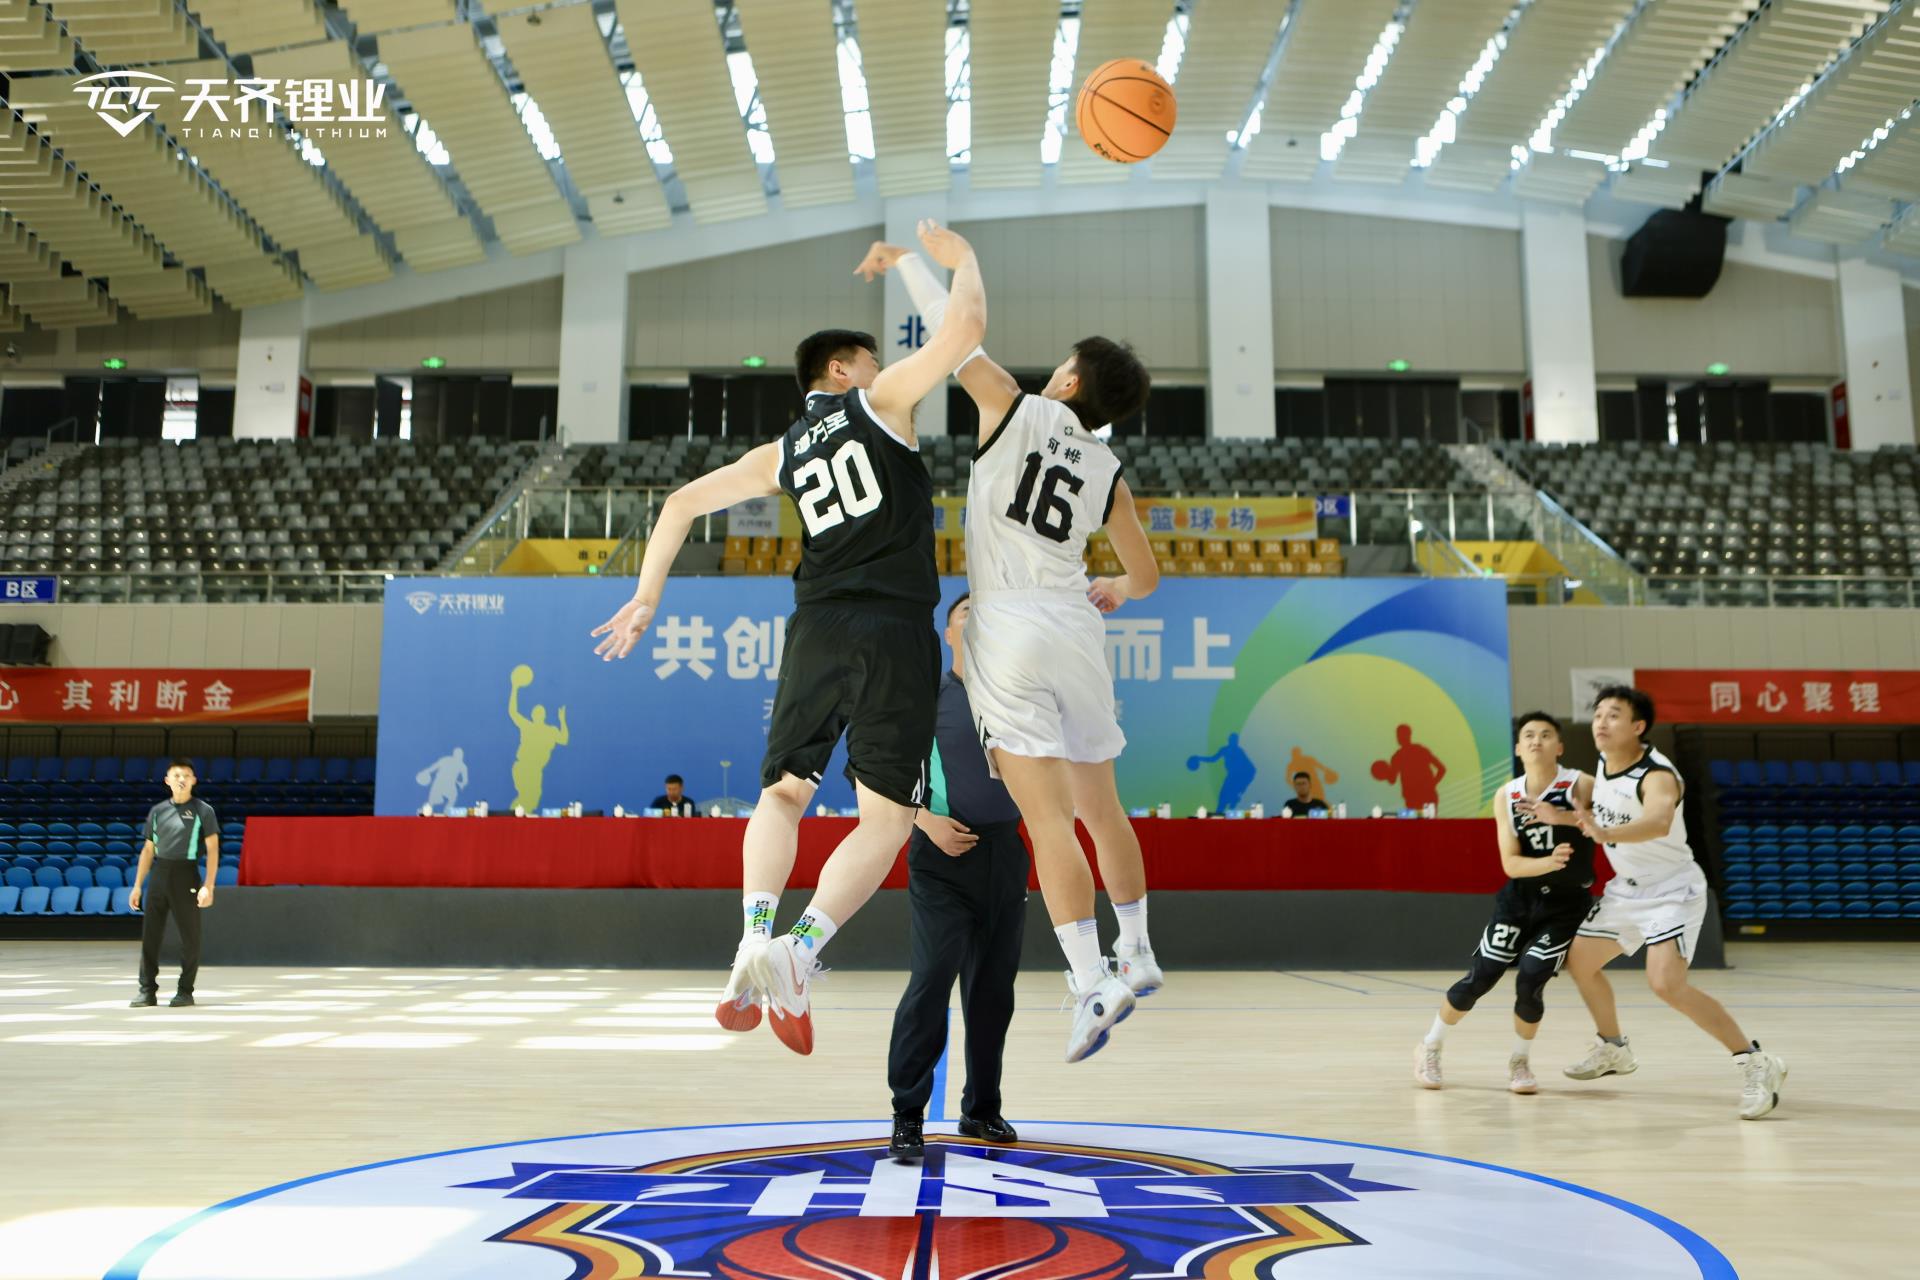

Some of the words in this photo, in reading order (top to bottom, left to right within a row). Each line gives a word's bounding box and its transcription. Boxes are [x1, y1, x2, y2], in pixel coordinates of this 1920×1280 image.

[793, 440, 883, 538] 20
[1005, 450, 1085, 543] 16
[1149, 506, 1257, 532] 篮球场
[6, 581, 38, 598] B区
[652, 616, 785, 681] 共创
[1104, 617, 1236, 682] 而上
[62, 679, 234, 711] 其利断金
[1710, 681, 1881, 713] 同心聚锂
[1525, 826, 1555, 850] 27
[1491, 923, 1521, 949] 27
